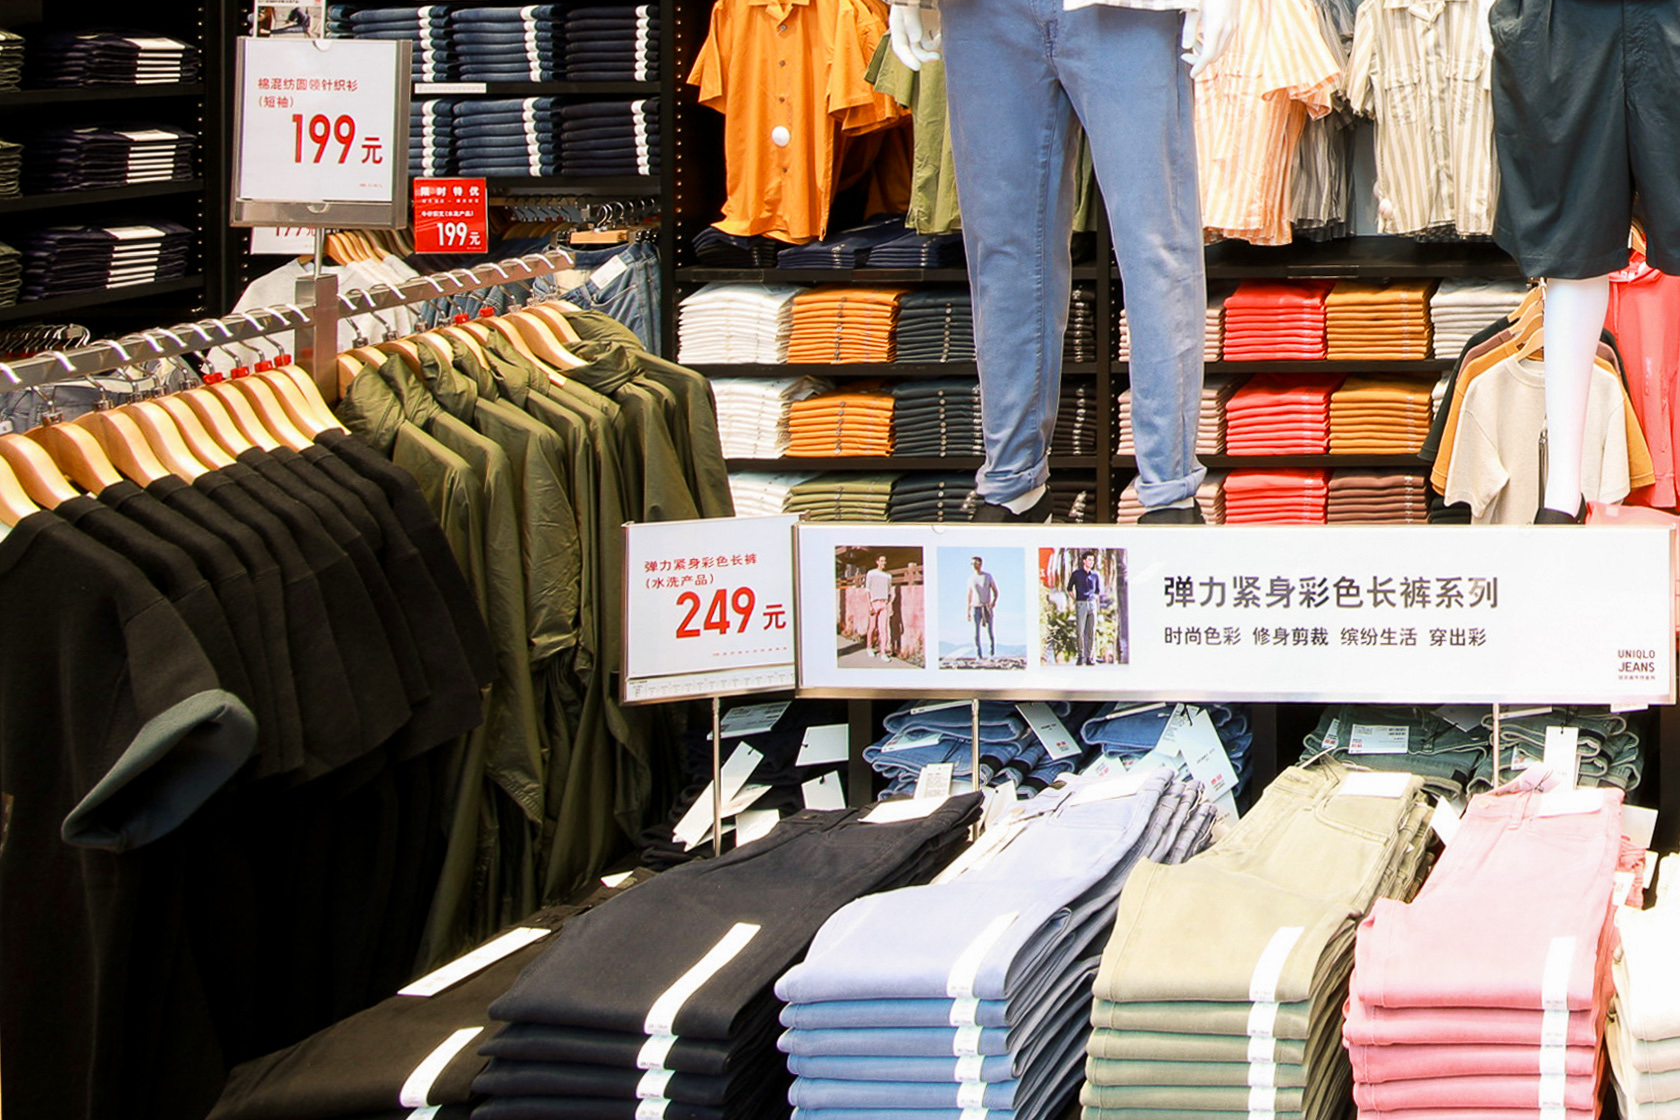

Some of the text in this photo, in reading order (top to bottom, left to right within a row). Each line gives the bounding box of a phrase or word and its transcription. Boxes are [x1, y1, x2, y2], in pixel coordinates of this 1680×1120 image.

[644, 553, 757, 573] 弹力紧身彩色长裤
[1163, 575, 1499, 609] 弹力紧身彩色长裤系列
[1164, 626, 1487, 647] 时尚色彩 修身剪裁 缤纷生活 穿出彩
[1618, 649, 1655, 659] UNIQLO
[1618, 662, 1655, 672] JEANS
